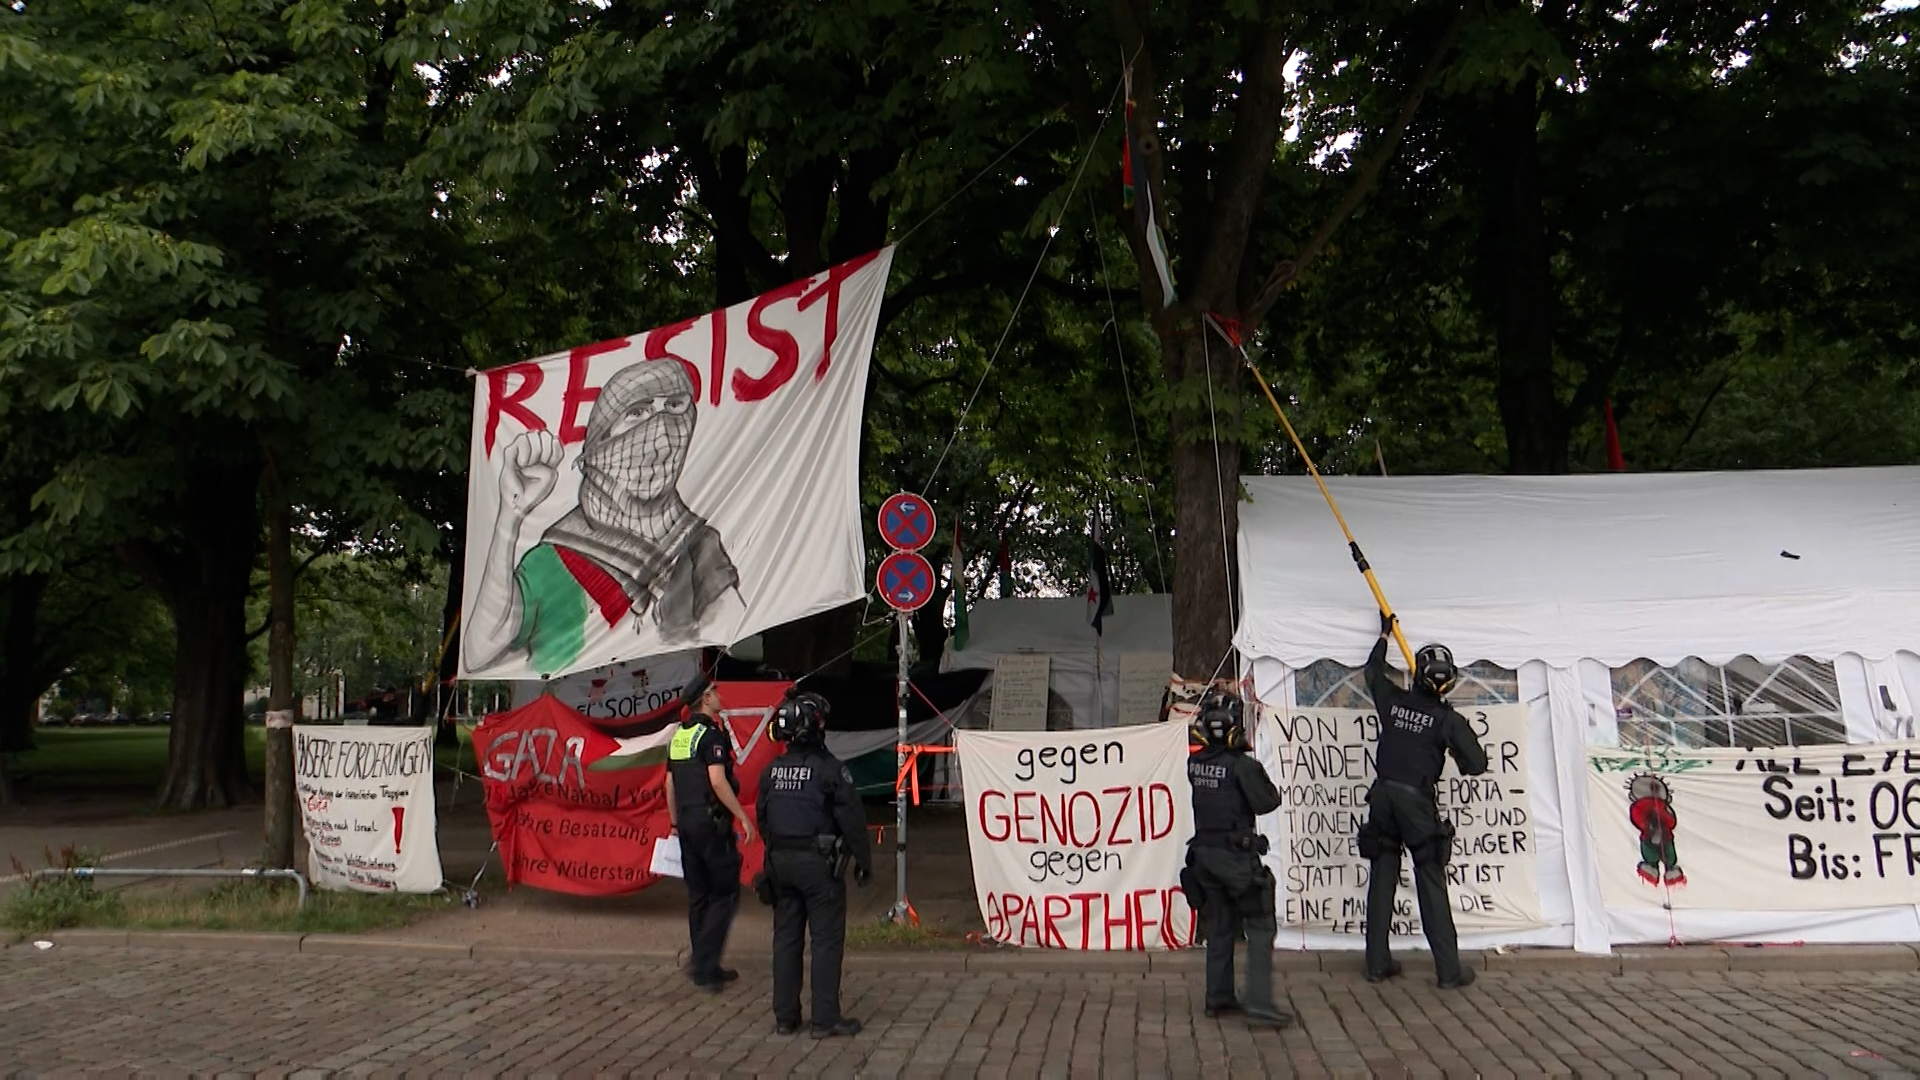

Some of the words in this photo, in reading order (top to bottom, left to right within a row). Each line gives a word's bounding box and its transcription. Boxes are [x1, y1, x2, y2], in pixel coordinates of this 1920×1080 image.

[481, 250, 880, 460] RESIST
[605, 686, 684, 718] SOFORT
[1390, 705, 1434, 728] POLIZEI
[1275, 714, 1337, 744] VON
[335, 735, 432, 780] FORDERUNGEN
[483, 727, 584, 788] GAZA
[770, 766, 811, 780] POLIZEI
[1015, 741, 1123, 783] gegen
[1189, 763, 1226, 778] POLIZEI
[1279, 744, 1380, 780] FANDEN
[1484, 741, 1519, 773] ER
[1279, 784, 1370, 807] MOORWEID
[1763, 775, 1856, 822] Seit:
[979, 783, 1174, 847] GENOZID
[1284, 810, 1363, 834] TIONEN
[560, 819, 651, 846] Besatzung
[1028, 850, 1122, 884] gegen
[1788, 833, 1862, 880] Bis:
[1286, 863, 1346, 893] STATT
[1446, 863, 1469, 885] RT
[1475, 864, 1504, 883] IST
[987, 886, 1196, 951] APARTHEID
[1286, 897, 1332, 923] EINE
[1459, 895, 1494, 912] DIE
